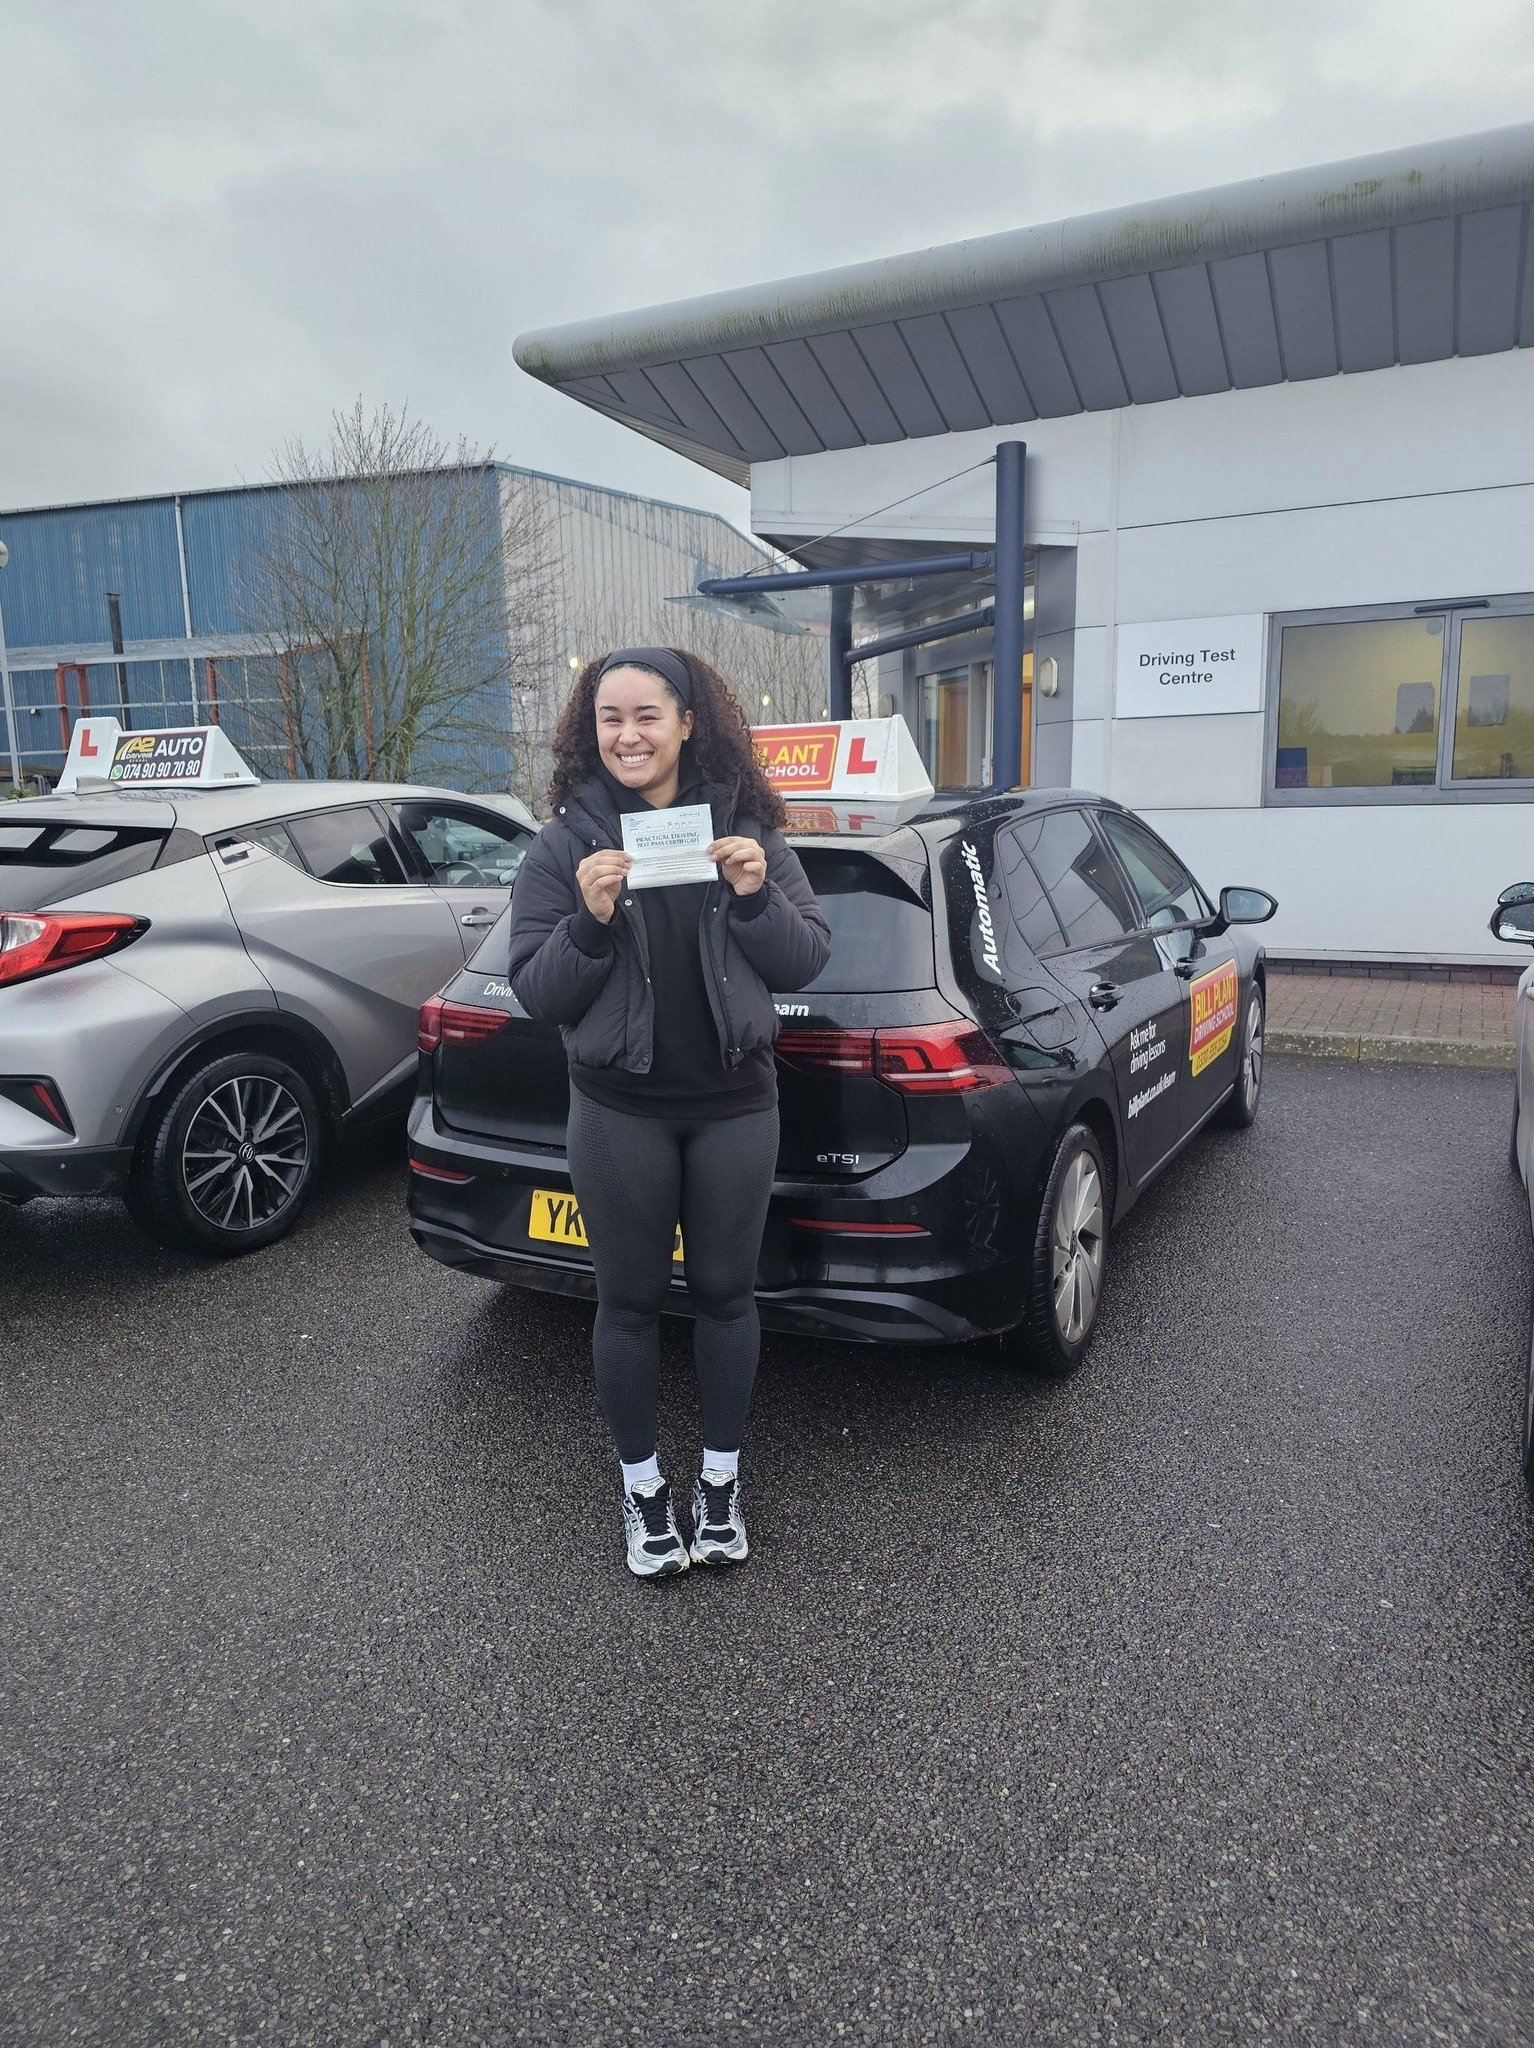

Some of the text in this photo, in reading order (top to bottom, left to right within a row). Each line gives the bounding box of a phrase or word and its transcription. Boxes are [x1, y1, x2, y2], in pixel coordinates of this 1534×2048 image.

[1139, 648, 1236, 667] Driving Test
[1159, 671, 1213, 685] Centre
[79, 729, 99, 757] L
[127, 736, 156, 753] A2
[154, 737, 204, 757] AUTO
[760, 744, 824, 766] LANT
[846, 737, 878, 775] L
[123, 760, 200, 779] 074 90 90 70 80
[635, 832, 700, 843] PRACTICAL DRIVING
[665, 837, 700, 846] CERTIFICATE
[961, 840, 1002, 976] Automatic
[1194, 972, 1234, 1025] BILL PLANT
[773, 1003, 810, 1017] earn
[1215, 1001, 1234, 1028] SCHOOL
[1130, 1020, 1157, 1051] Ask me for
[1130, 1039, 1166, 1074] driving lessons
[816, 1153, 860, 1165] eTSI
[546, 1197, 582, 1238] YK
